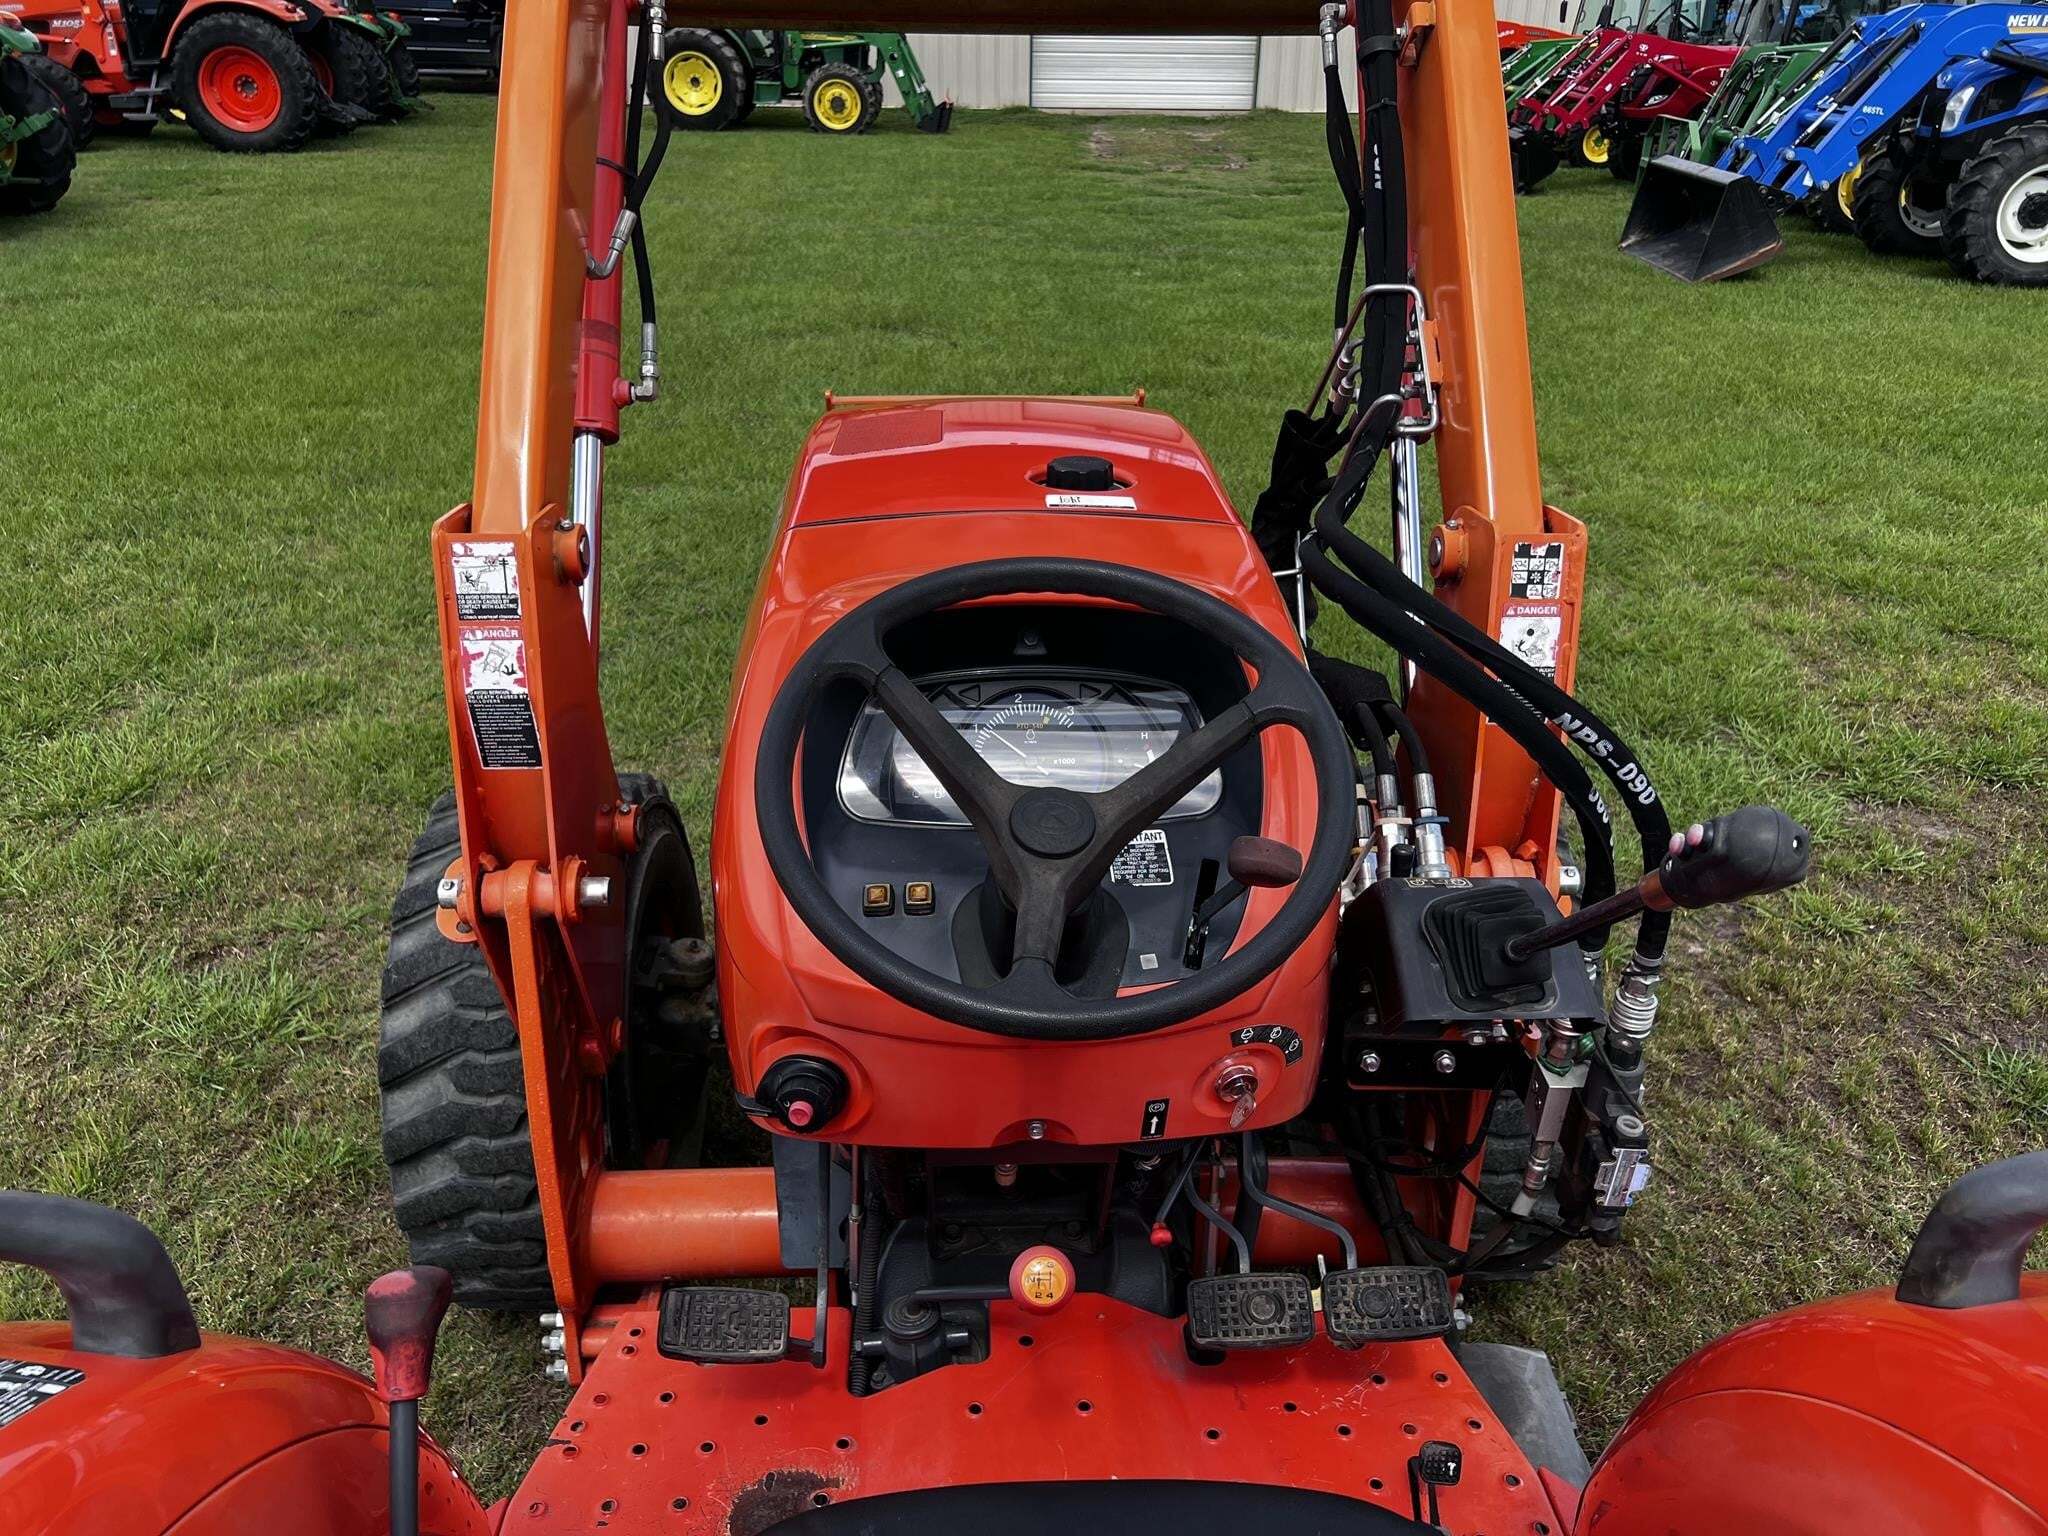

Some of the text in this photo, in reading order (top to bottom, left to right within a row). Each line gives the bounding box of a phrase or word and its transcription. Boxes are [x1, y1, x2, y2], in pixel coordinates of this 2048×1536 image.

[2007, 15, 2042, 27] NEW
[1516, 606, 1557, 615] DANGER
[475, 629, 519, 639] ANGER
[1014, 693, 1023, 704] 2
[1066, 705, 1075, 716] 3
[974, 724, 979, 734] 1
[1140, 732, 1149, 740] H
[1053, 757, 1076, 766] x1000
[1552, 712, 1657, 806] NPS-D90
